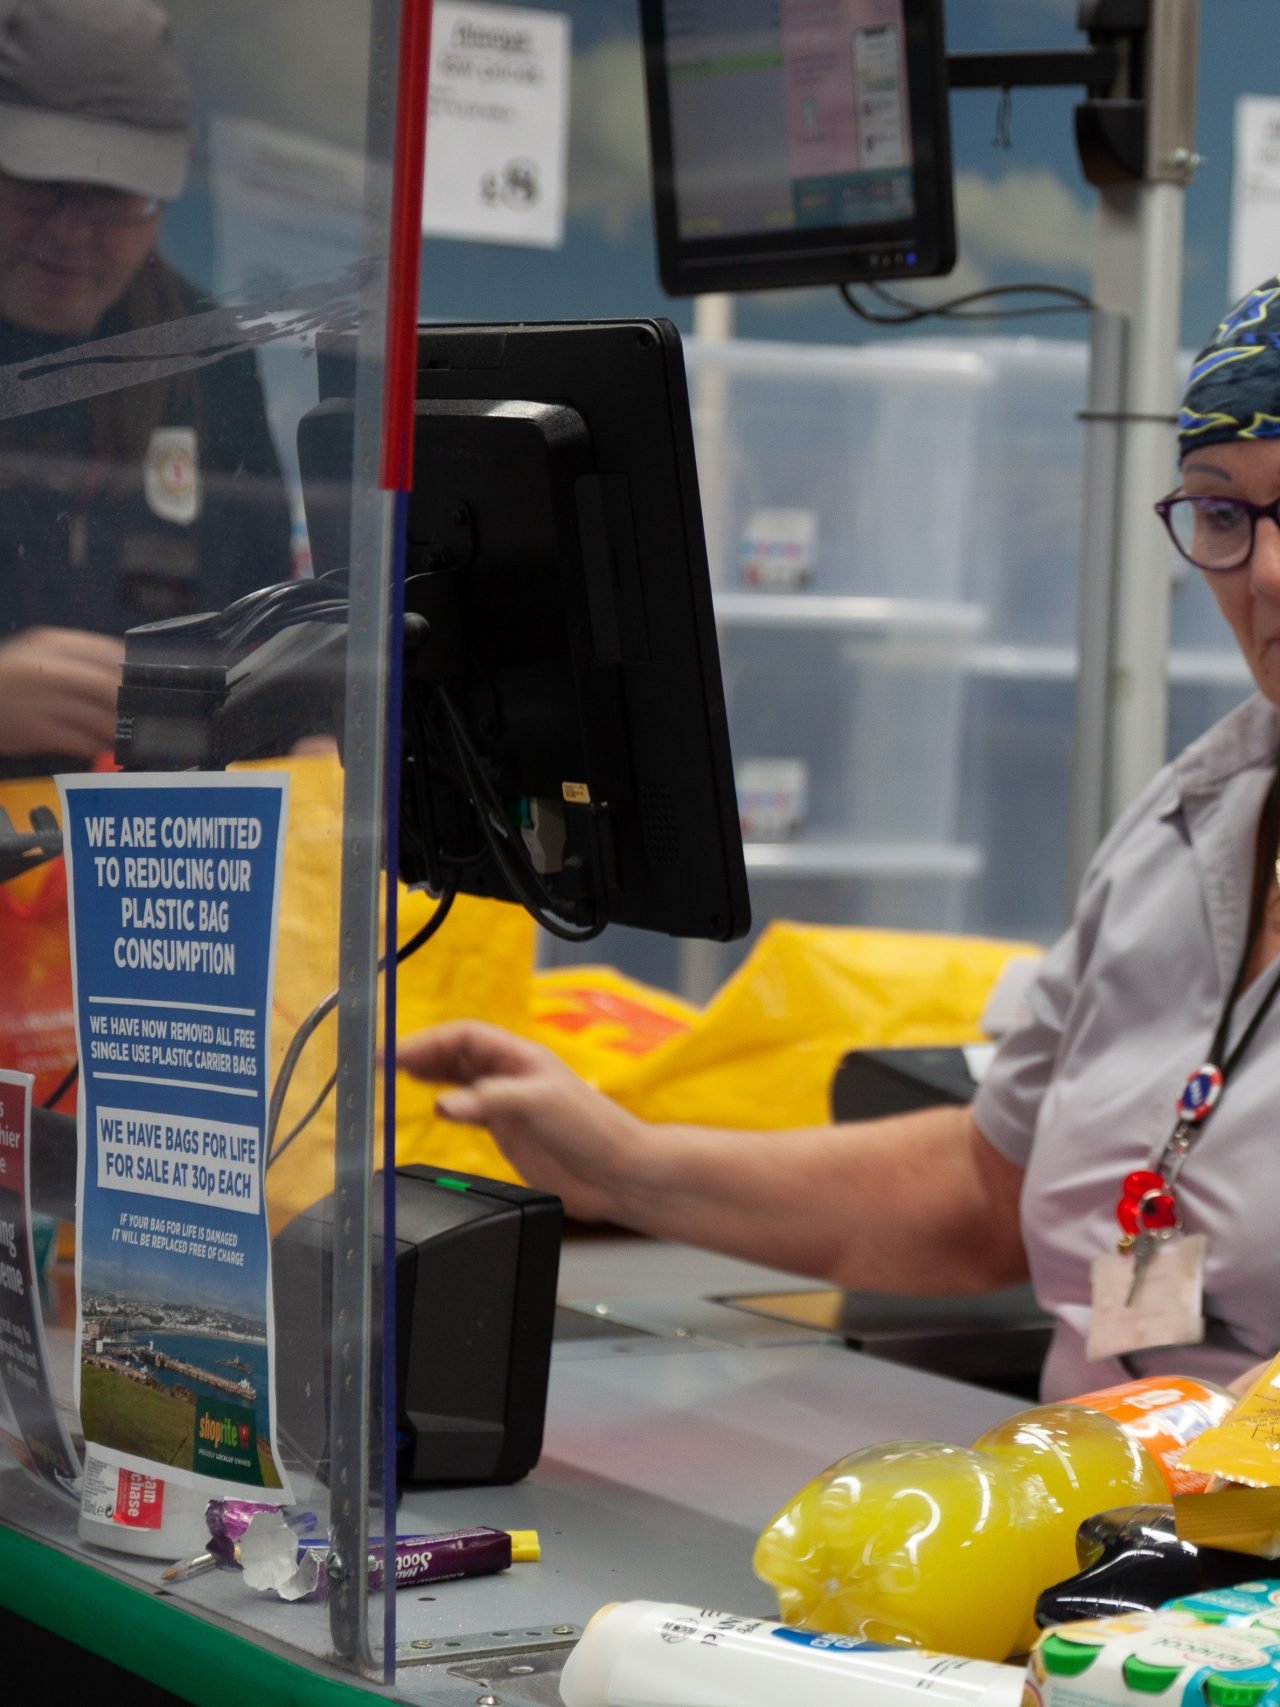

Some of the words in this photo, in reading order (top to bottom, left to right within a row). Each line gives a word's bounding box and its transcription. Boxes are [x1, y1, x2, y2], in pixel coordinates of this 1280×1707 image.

[84, 816, 116, 848] WE
[119, 816, 157, 848] ARE
[160, 816, 262, 850] COMMITTED
[94, 856, 120, 888] TO
[124, 857, 215, 891] REDUCING
[217, 858, 251, 892] OUR
[121, 897, 195, 931] PLASTIC
[199, 899, 230, 933] BAG
[113, 936, 235, 976] CONSUMPTION
[89, 1015, 108, 1035] WE
[110, 1016, 140, 1037] HAVE
[141, 1019, 167, 1040] NOW
[170, 1021, 214, 1045] REMOVED
[215, 1026, 232, 1048] ALL
[233, 1028, 256, 1050] FREE
[90, 1040, 130, 1062] SINGLE
[131, 1043, 151, 1064] USE
[151, 1046, 193, 1068] PLASTIC
[194, 1051, 232, 1074] CARRIER
[232, 1055, 257, 1077] BAGS
[100, 1117, 123, 1144] WE
[126, 1120, 162, 1150] HAVE
[165, 1126, 199, 1155] BAGS
[202, 1131, 227, 1159] FOR
[229, 1135, 256, 1165] LIFE
[106, 1151, 134, 1179] FOR
[136, 1155, 169, 1185] SALE
[172, 1161, 189, 1188] AT
[191, 1165, 216, 1197] 30p
[218, 1169, 252, 1200] EACH
[111, 1227, 121, 1241] IT
[121, 1229, 139, 1245] WILL
[139, 1233, 151, 1247] BE
[151, 1235, 188, 1254] REPLACED
[188, 1242, 206, 1258] FREE
[207, 1247, 217, 1260] OF
[217, 1248, 245, 1267] CHARGE
[119, 1212, 128, 1226] IF
[128, 1213, 149, 1230] YOUR
[150, 1217, 166, 1233] BAG
[166, 1220, 181, 1235] FOR
[181, 1222, 197, 1239] LIFE
[197, 1226, 205, 1241] IS
[205, 1228, 238, 1248] DAMAGED
[199, 1412, 238, 1449] shoprite
[215, 1453, 234, 1463] LOCALLY
[234, 1457, 252, 1468] OWNED
